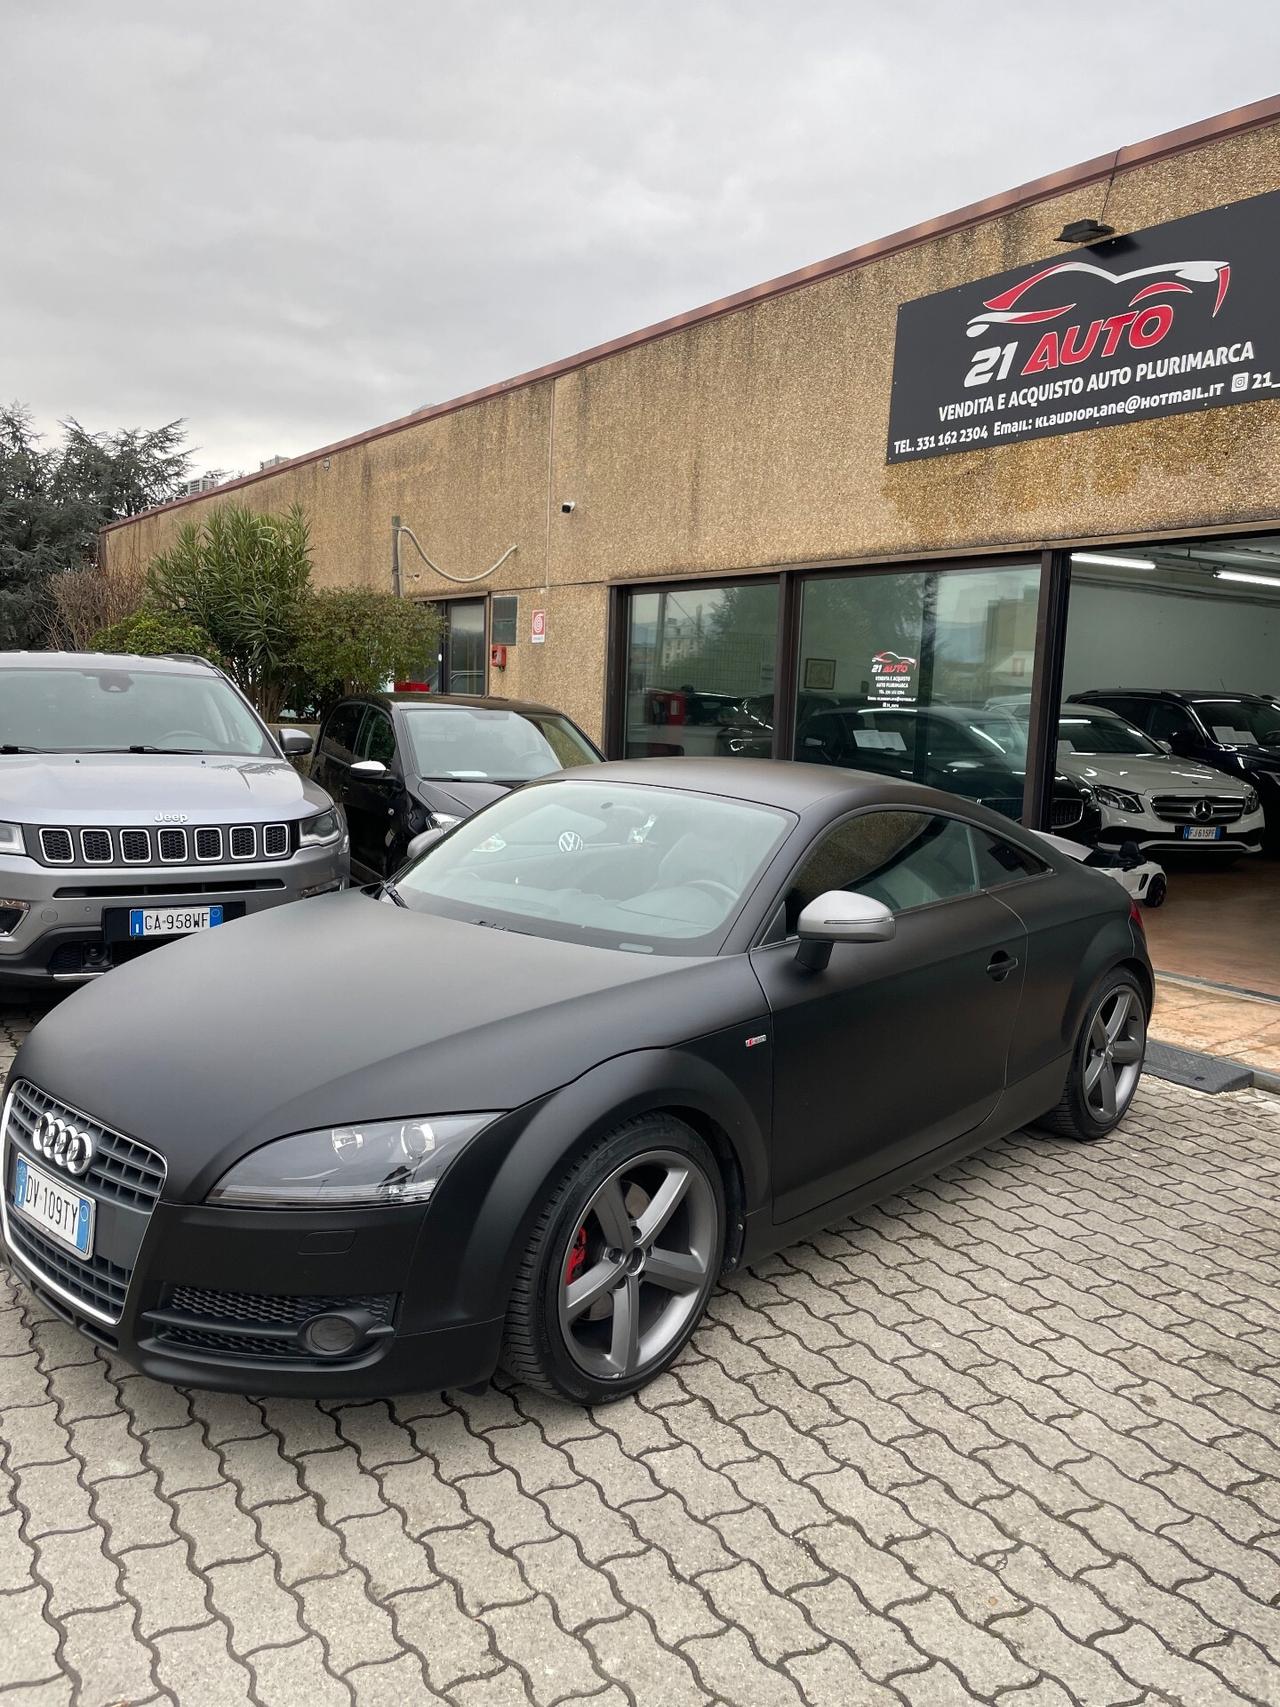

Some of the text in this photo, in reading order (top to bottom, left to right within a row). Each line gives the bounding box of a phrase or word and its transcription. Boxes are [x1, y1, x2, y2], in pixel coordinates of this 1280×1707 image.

[964, 304, 1174, 388] 21 AUTO
[938, 341, 1255, 422] VENDITA E ACQUISTO AUTO PLURIMARCA
[894, 439, 914, 455] TEL.
[916, 435, 936, 450] 331
[938, 431, 958, 446] 162
[960, 425, 988, 442] 2304
[871, 663, 909, 673] 21 AUTO
[154, 811, 189, 824] Jeep
